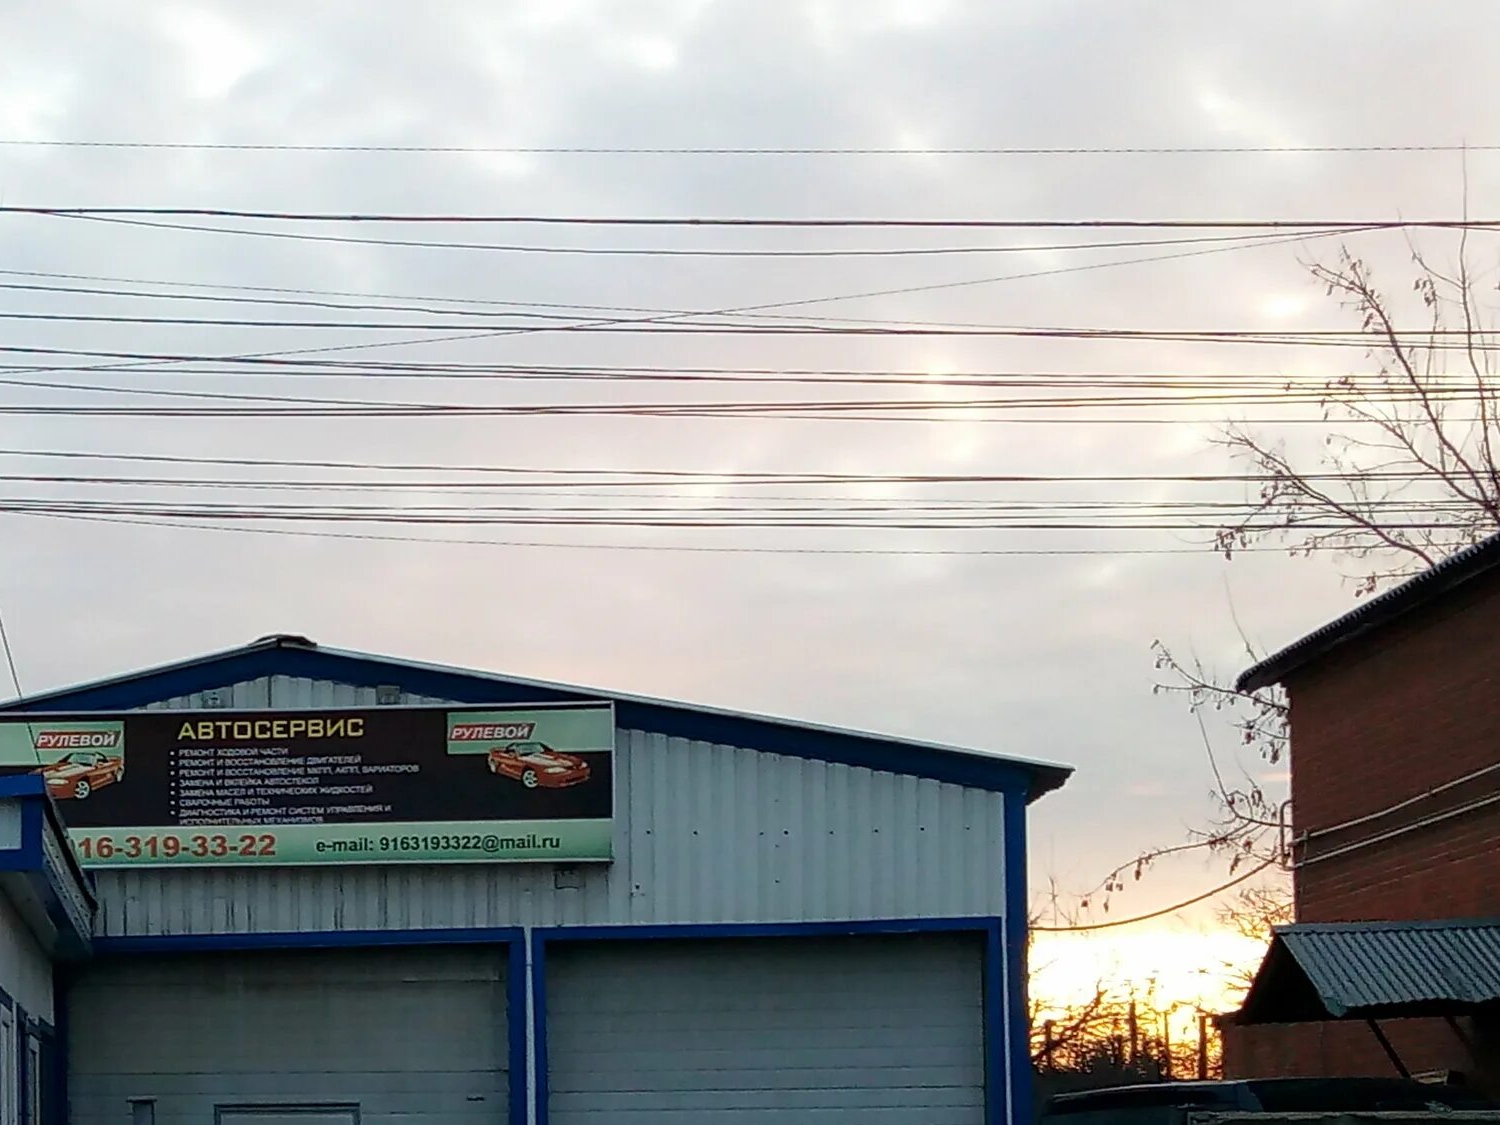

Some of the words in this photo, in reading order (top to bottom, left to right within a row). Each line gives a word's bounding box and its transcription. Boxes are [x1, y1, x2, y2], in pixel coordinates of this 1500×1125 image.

[177, 718, 364, 740] АВТОСЕРВИС
[451, 723, 530, 739] РУЛЕВОЙ
[37, 731, 116, 747] РУЛЕВОЙ
[179, 748, 214, 757] РЕМОНТ
[217, 748, 258, 756] ХОДОВОЙ
[260, 747, 289, 755] ЧАСТИ
[179, 758, 214, 767] РЕМОНТ
[225, 757, 305, 766] ВОССТАНОВЛЕНИЕ
[306, 755, 361, 765] ДВИГАТЕЛЕЙ
[179, 769, 214, 777] РЕМОНТ
[225, 767, 305, 776] ВОССТАНОВЛЕНИЕ
[362, 764, 419, 773] ВАРИАТОРОВ
[180, 779, 214, 787] ЗАМЕНА
[264, 776, 319, 785] АВТОСТЕКОЛ
[180, 789, 214, 797] ЗАМЕНА
[216, 788, 246, 796] МАСЕЛ
[256, 786, 318, 795] ТЕХНИЧЕСКИХ
[319, 784, 373, 794] ЖИДКОСТЕЙ
[179, 798, 232, 807] СВАРОЧНЫЕ
[234, 798, 270, 806] РАБОТЫ
[179, 808, 241, 817] ДИАГНОСТИКА
[250, 807, 286, 816] РЕМОНТ
[288, 806, 324, 815] СИСТЕМ
[326, 804, 383, 813] УПРАВЛЕНИЯ
[71, 834, 276, 858] 16-319-33-22
[316, 837, 373, 852] e-mail:
[379, 834, 560, 853] 9163193322@mail.ru
